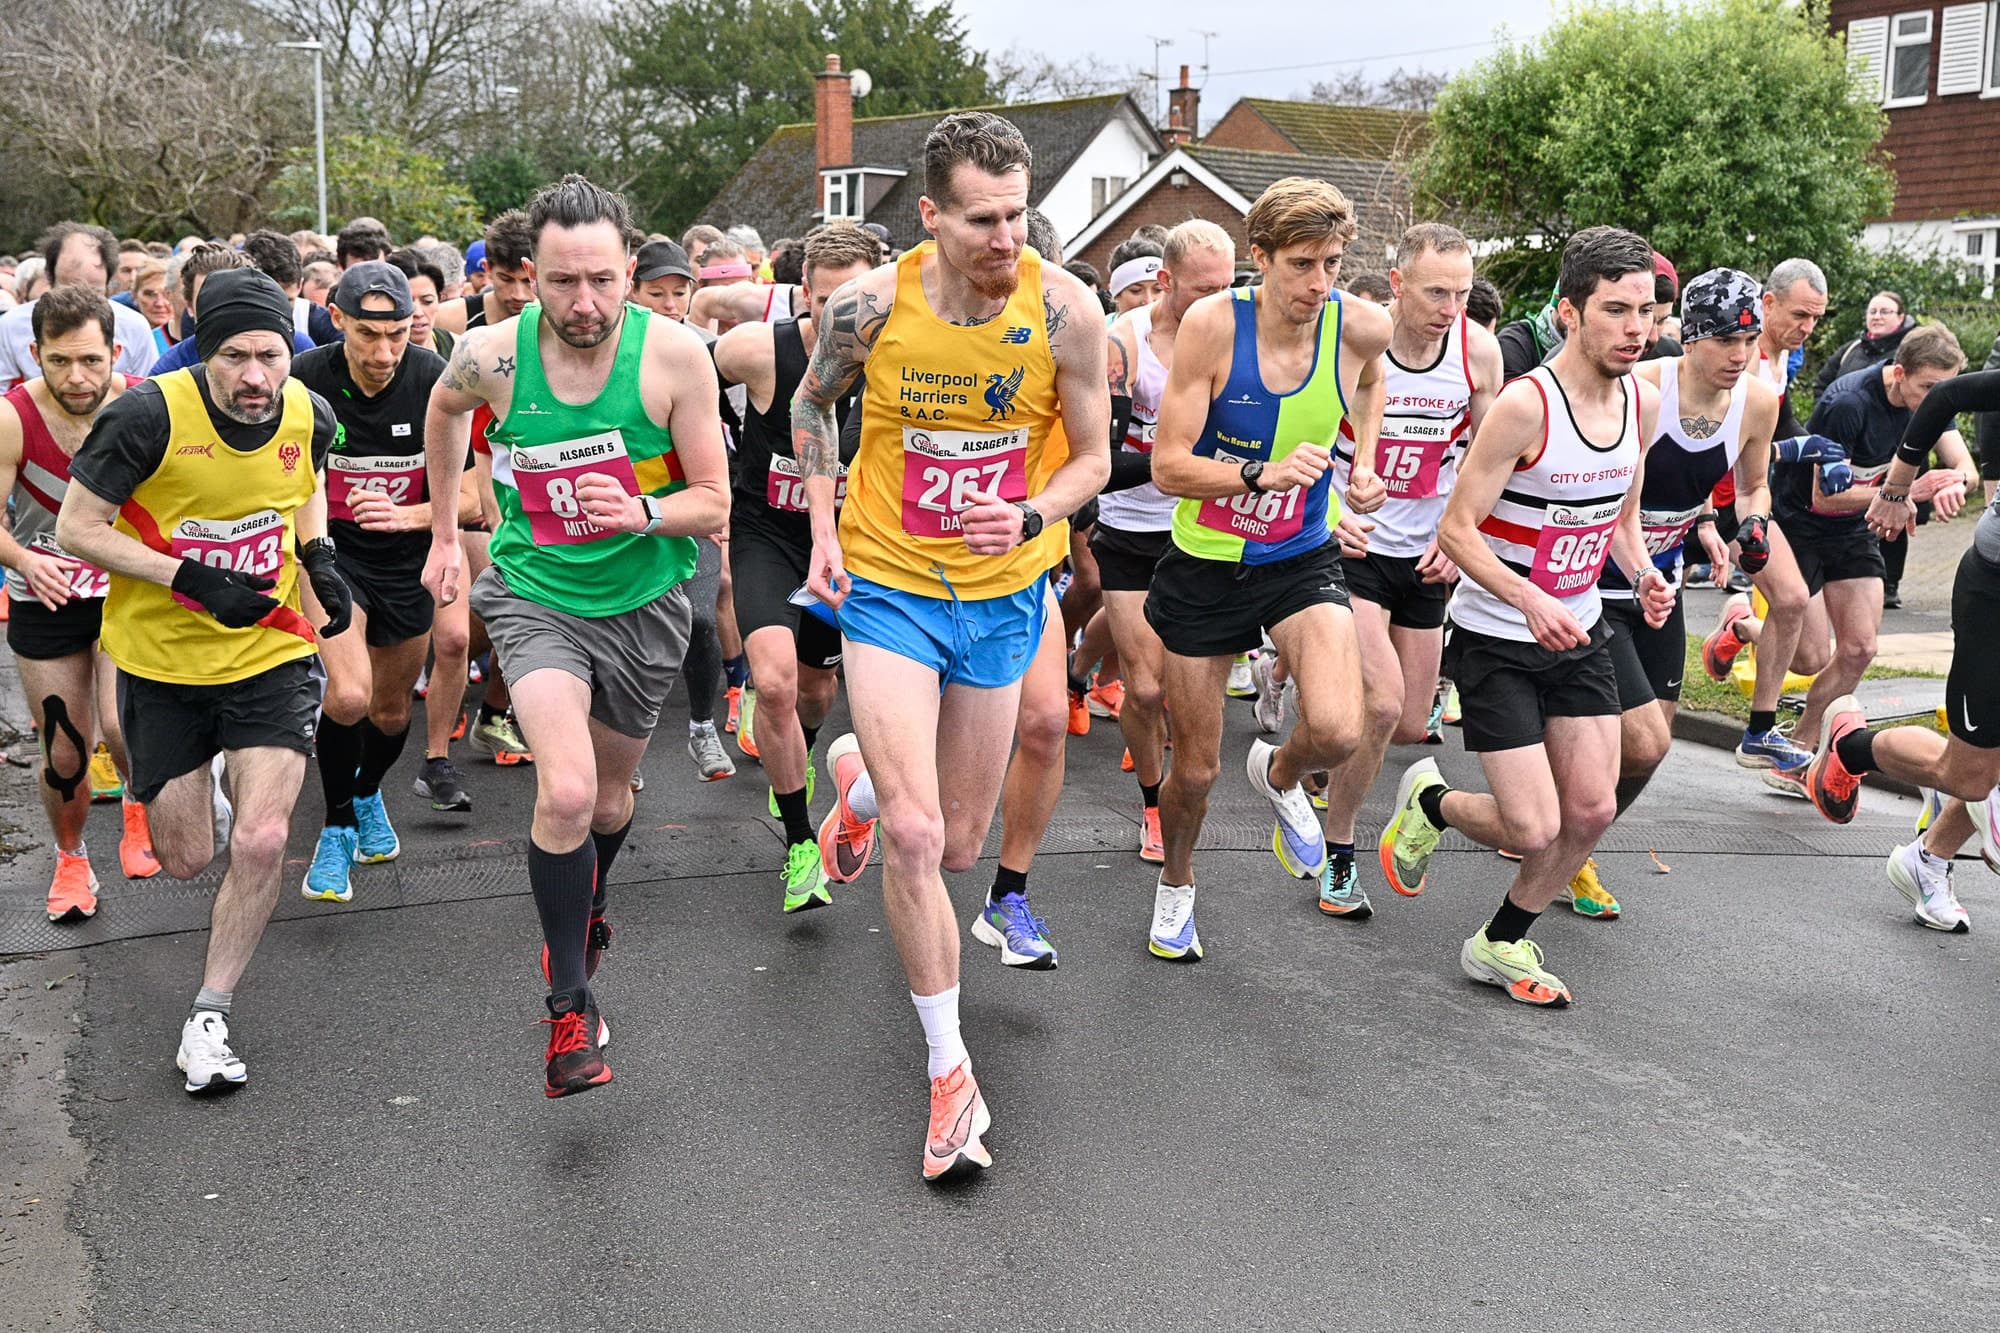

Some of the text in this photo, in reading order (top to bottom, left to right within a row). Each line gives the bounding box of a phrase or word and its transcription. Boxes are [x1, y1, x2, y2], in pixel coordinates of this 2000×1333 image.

[902, 366, 977, 388] Liverpool
[900, 387, 967, 405] Harriers
[1402, 397, 1445, 409] STOKE
[900, 406, 949, 421] & A.C.
[1133, 402, 1156, 417] CITY
[1403, 425, 1445, 436] ALSAGER 5
[559, 442, 615, 462] ALSAGER 5
[918, 439, 939, 451] VELO
[919, 446, 950, 457] RUNNER
[962, 435, 1018, 452] ALSAGER 5
[1249, 440, 1262, 449] AC
[518, 456, 538, 465] VELO
[1384, 445, 1424, 479] 15
[1550, 474, 1579, 484] CITY
[1582, 472, 1597, 482] OF
[1598, 466, 1628, 481] STOKE
[344, 476, 411, 504] 762
[917, 459, 1010, 513] 267
[188, 525, 209, 533] VELO
[231, 514, 276, 536] ALSAGER 5
[1231, 514, 1269, 536] CHRIS
[188, 531, 220, 540] RUNNER
[1546, 525, 1614, 573] 965
[1554, 569, 1594, 590] JORDAN
